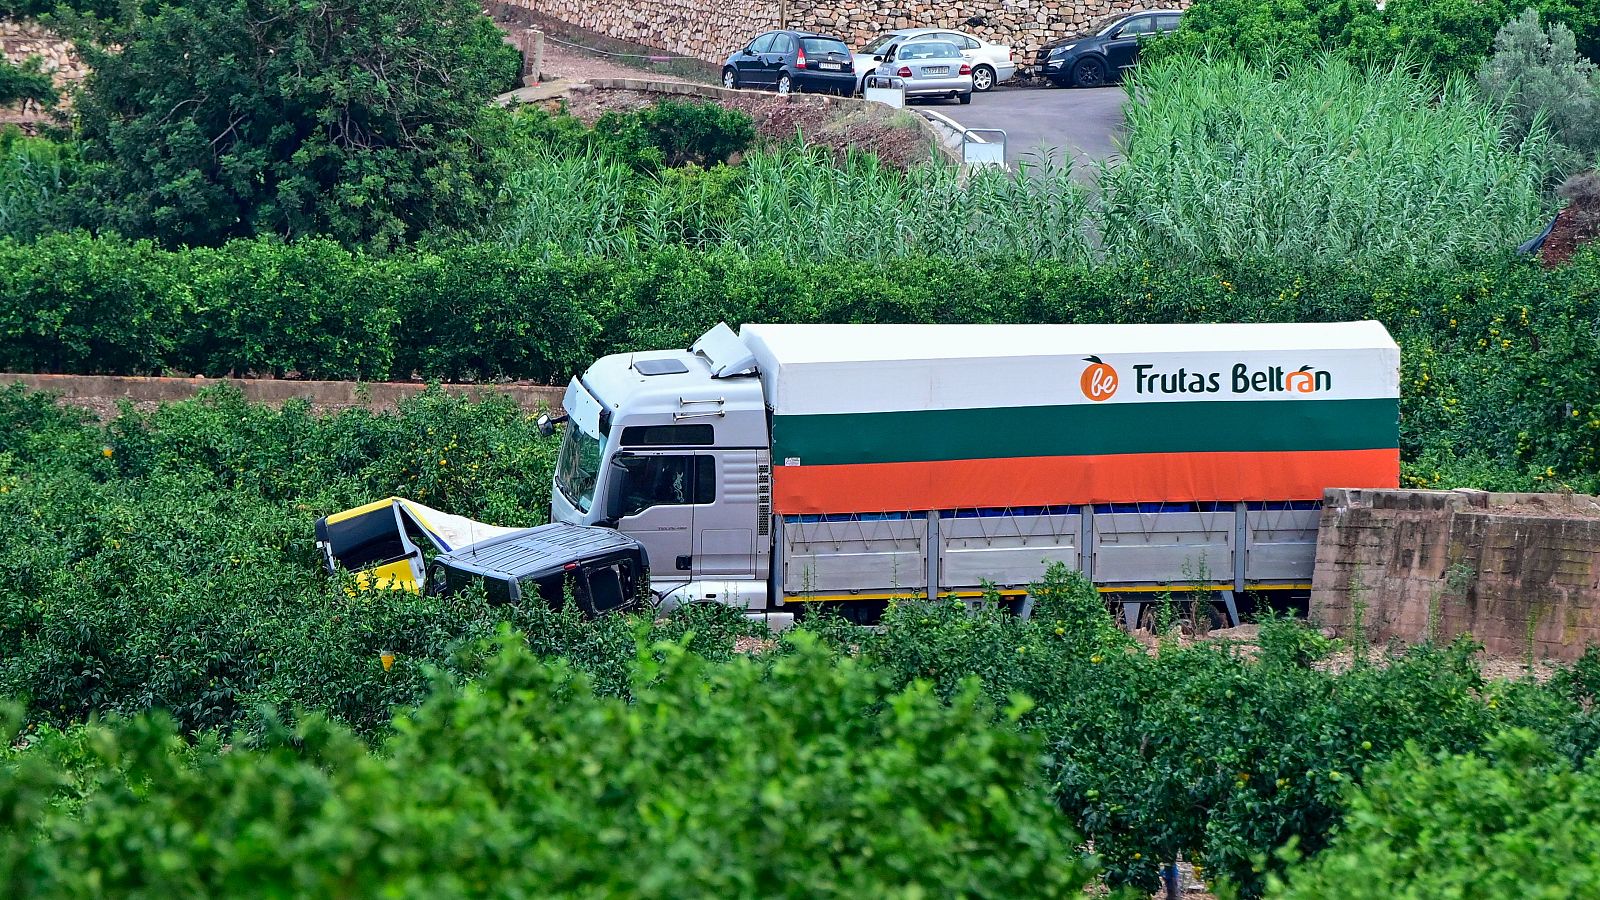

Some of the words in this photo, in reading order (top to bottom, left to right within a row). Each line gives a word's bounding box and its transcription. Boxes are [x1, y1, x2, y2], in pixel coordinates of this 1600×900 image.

[1090, 367, 1116, 397] be
[1132, 364, 1220, 394] Frutas
[1231, 363, 1332, 393] Beltrán
